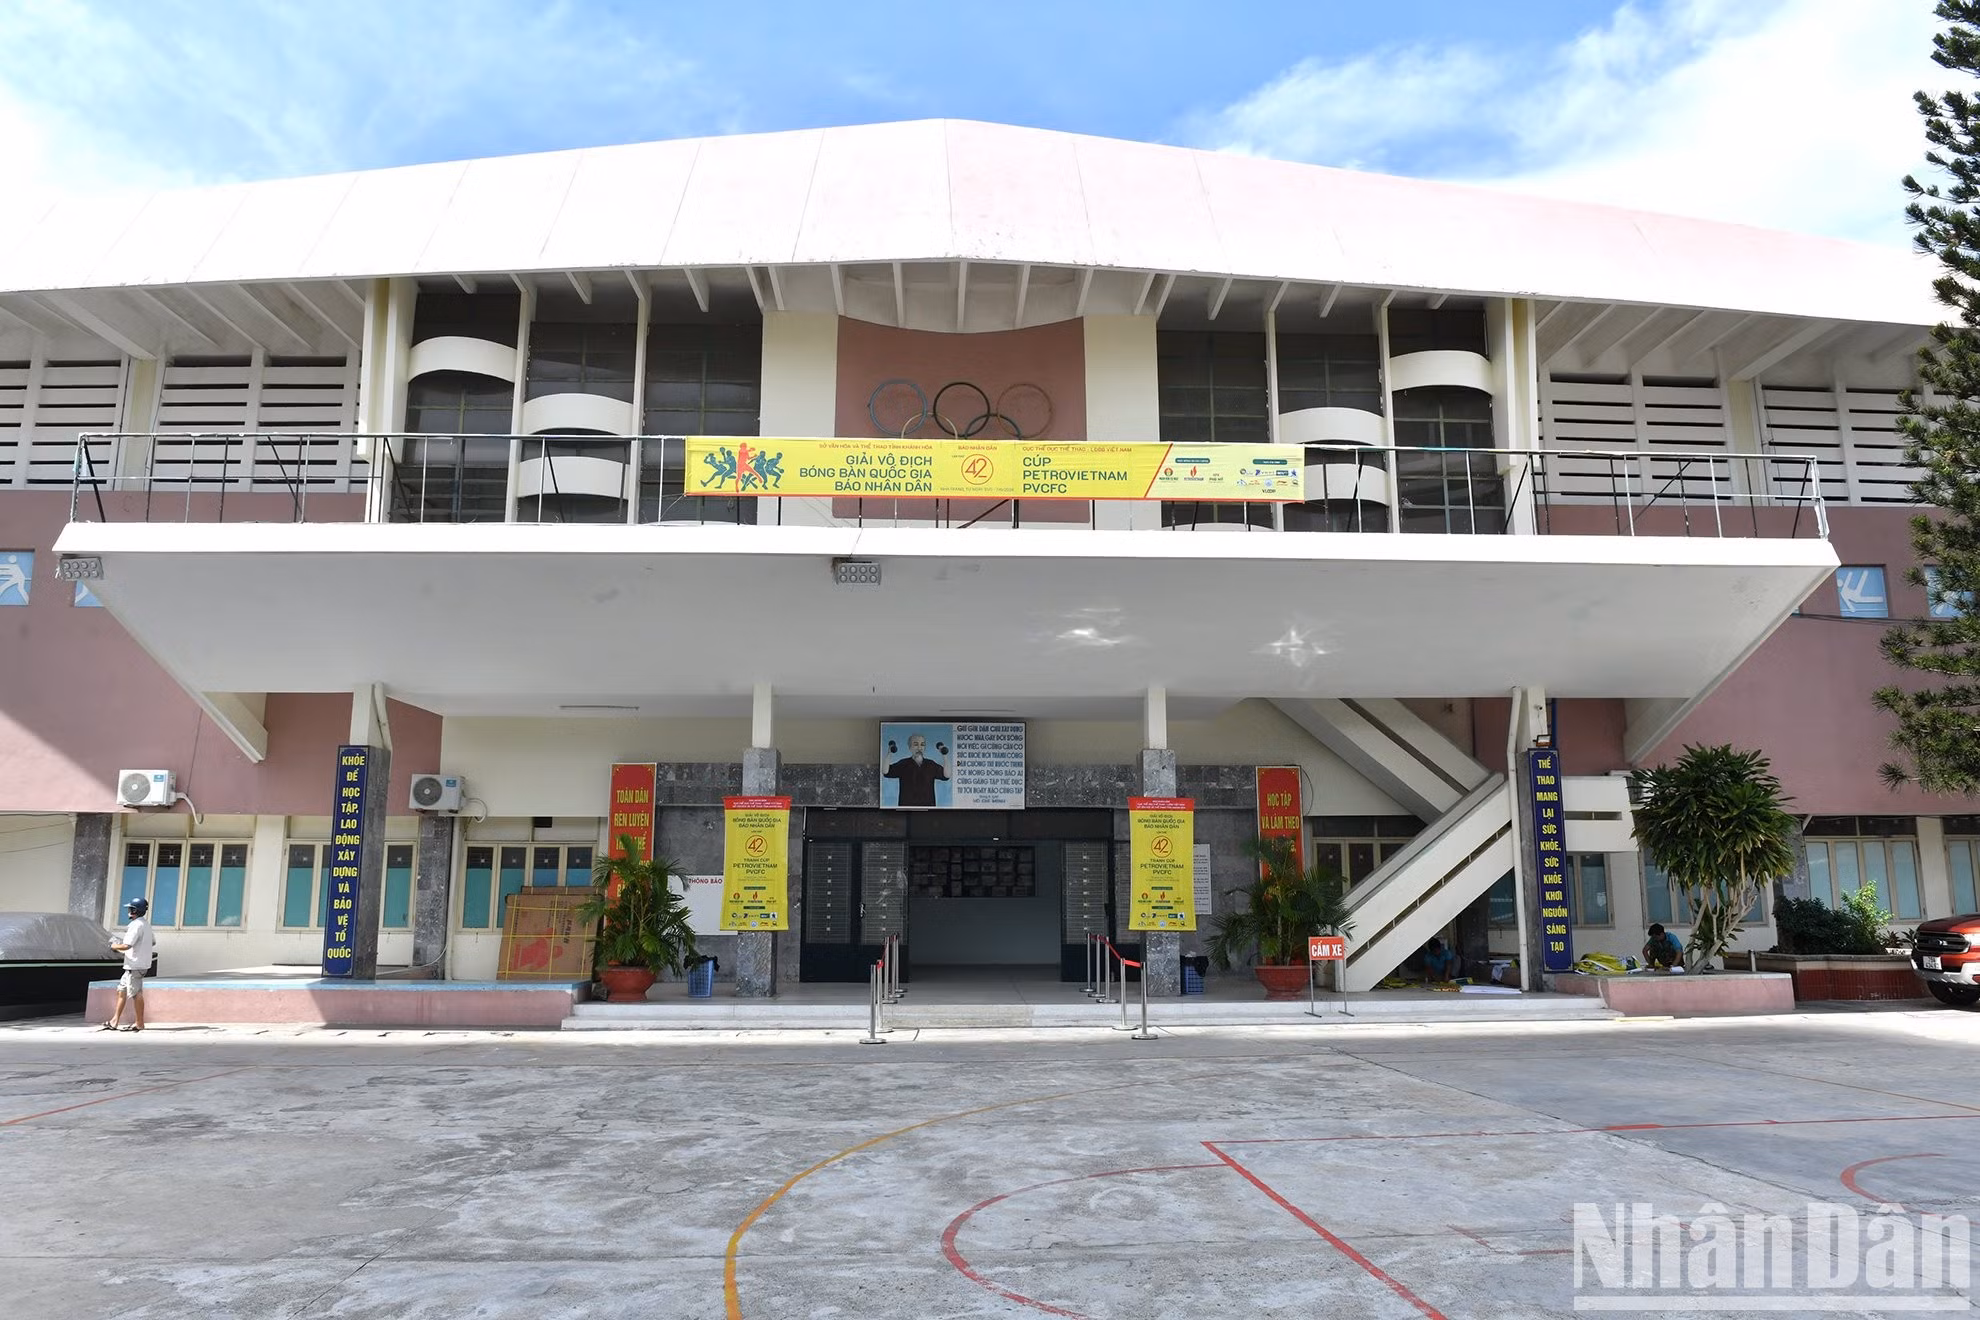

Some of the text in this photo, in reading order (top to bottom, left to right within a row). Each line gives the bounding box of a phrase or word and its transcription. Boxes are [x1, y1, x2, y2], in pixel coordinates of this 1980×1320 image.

[846, 452, 872, 465] GIẢI
[900, 456, 932, 468] ĐỊCH
[1023, 454, 1051, 466] CÚP
[800, 464, 932, 478] BÓNG BÀN QUỐC GIA
[965, 458, 987, 478] 42
[1023, 470, 1128, 480] PETROVIETNAM
[836, 478, 932, 492] BÁO NHÂN DÂN
[1023, 483, 1068, 493] PVCFC
[342, 753, 366, 766] KHỎE
[1538, 756, 1552, 768] THỂ
[347, 768, 359, 782] ĐỂ
[1536, 776, 1555, 784] THAO
[342, 787, 361, 799] HỌC
[616, 787, 648, 803] TOÀN DÂN
[1267, 790, 1292, 809] HỌC TẬP
[1536, 792, 1558, 801] MANG
[614, 810, 649, 830] RÈN LUYỆN
[1262, 812, 1300, 829] VÀ LÀM THEO
[1542, 808, 1554, 820] LẠI
[340, 819, 358, 829] LAO
[1542, 823, 1557, 834] SỨC
[336, 833, 360, 847] ĐỘNG
[748, 838, 764, 852] 42
[1154, 838, 1168, 853] 42
[338, 848, 356, 860] XÂY
[1544, 856, 1560, 867] SỨC
[333, 866, 358, 878] DỰNG
[1543, 871, 1562, 884] KHỎE
[338, 881, 350, 893] VÀ
[1545, 890, 1562, 900] KHƠI
[334, 896, 352, 909] BẢO
[338, 914, 348, 928] VỆ
[1546, 922, 1566, 934] SÁNG
[328, 944, 352, 958] QUỐC
[1312, 940, 1342, 956] CẤM XE
[1550, 941, 1564, 954] TẠO
